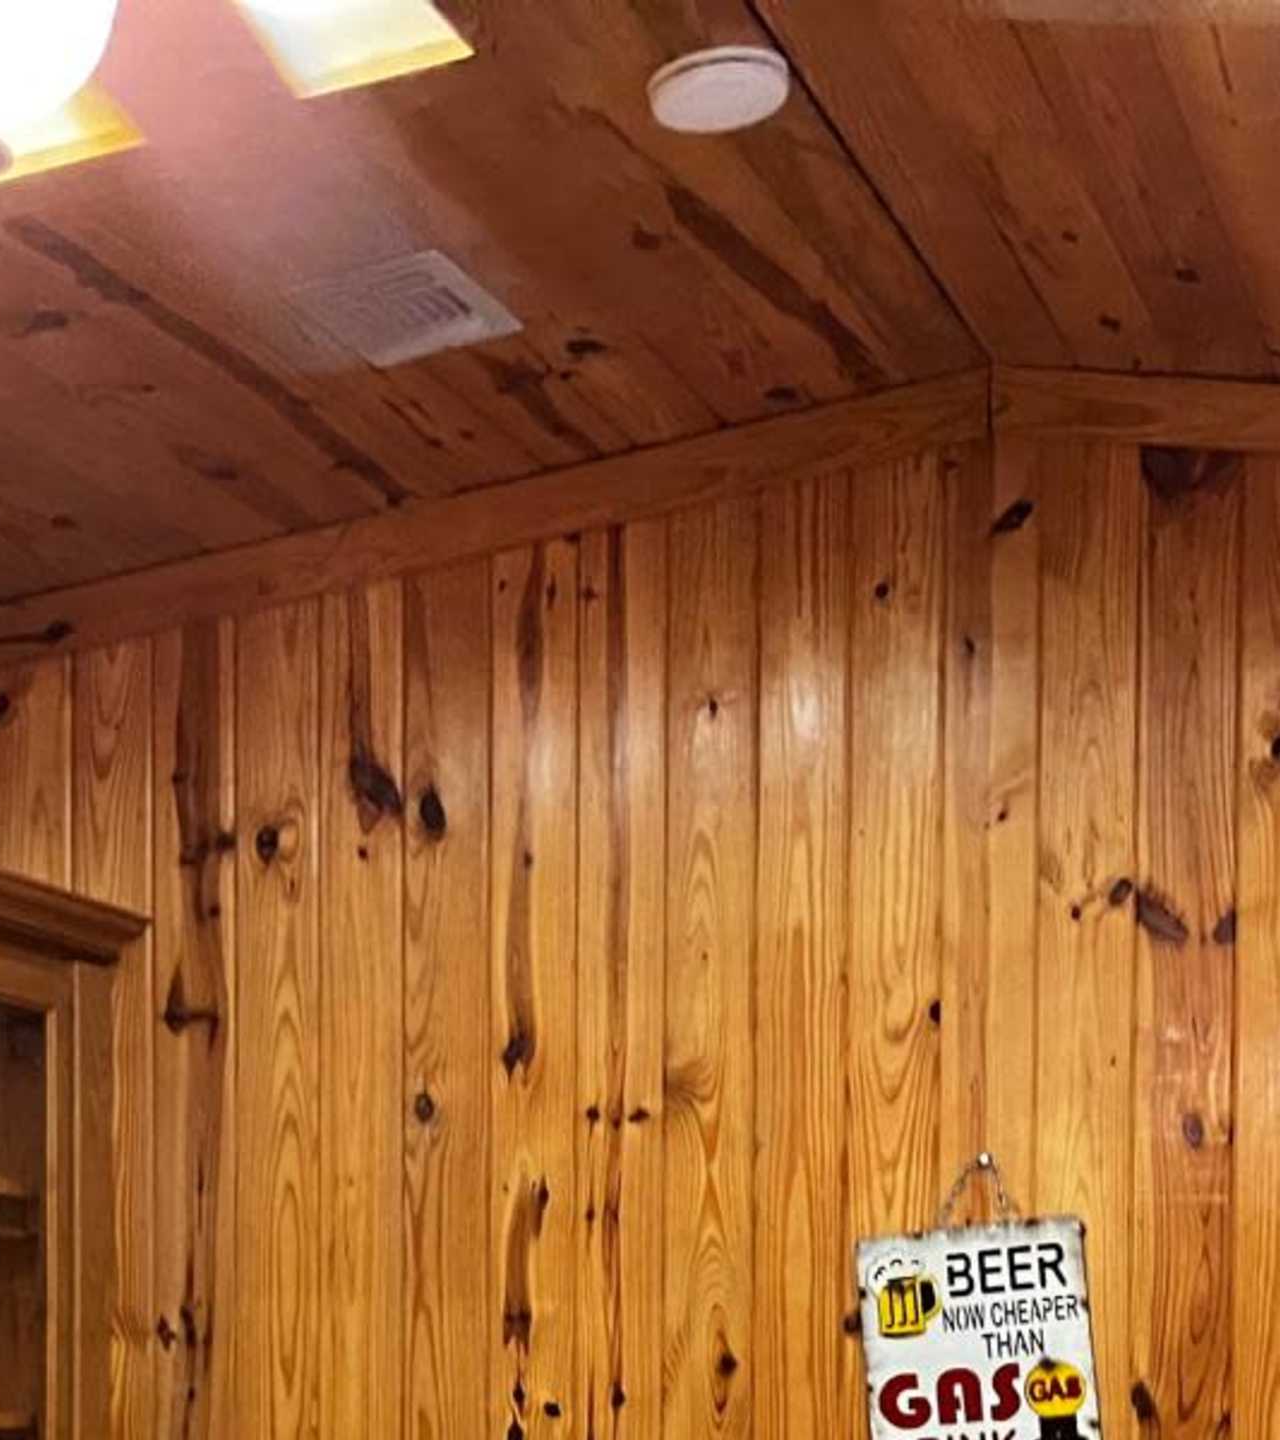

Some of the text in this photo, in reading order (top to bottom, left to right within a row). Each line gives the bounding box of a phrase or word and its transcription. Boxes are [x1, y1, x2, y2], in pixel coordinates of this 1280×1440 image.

[946, 1243, 1067, 1297] BEER
[942, 1295, 1080, 1334] NOW CHEAPER
[982, 1330, 1046, 1359] THAN
[878, 1362, 1021, 1429] GAS
[1028, 1375, 1082, 1402] GAS
